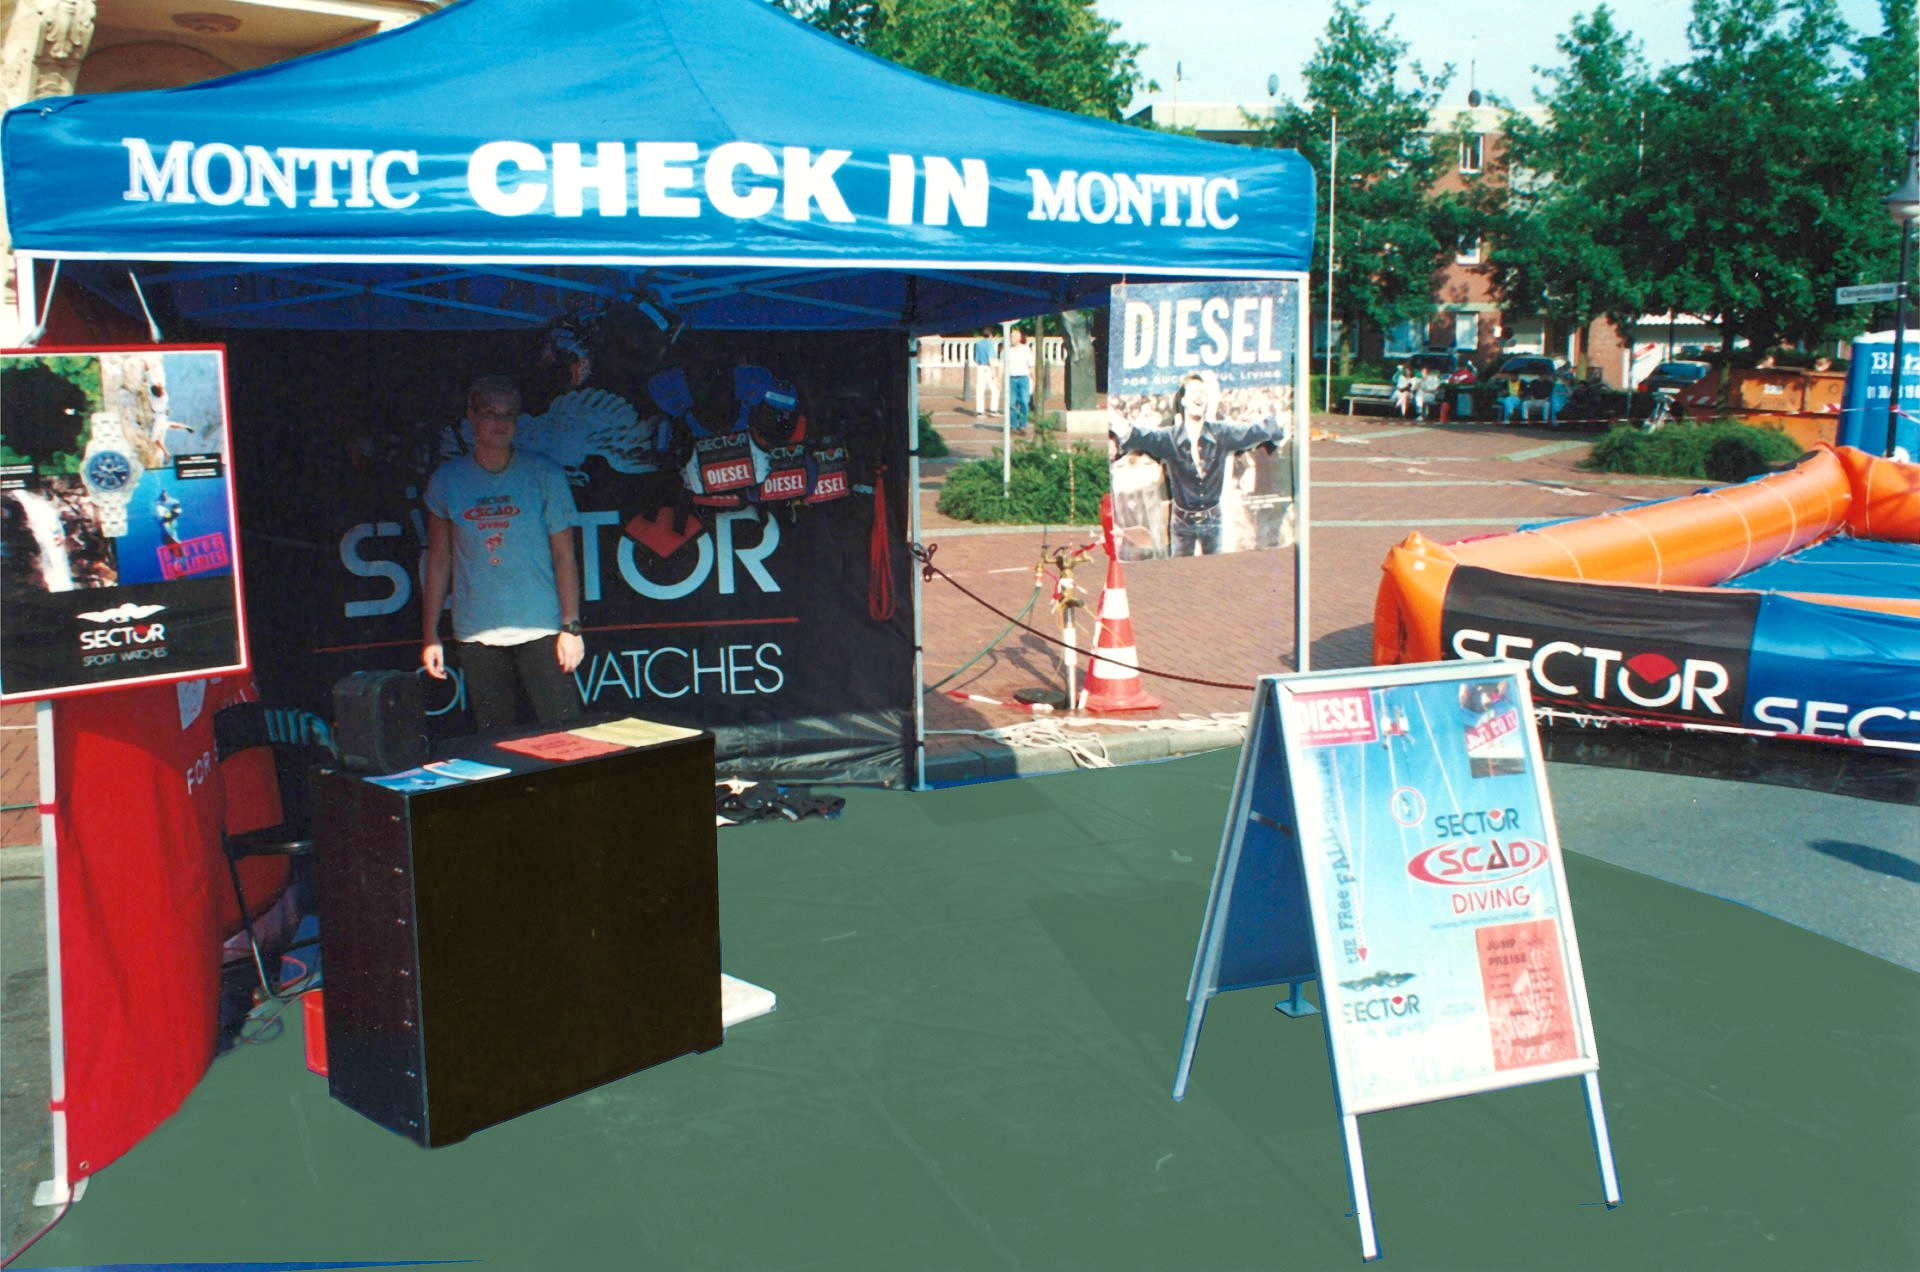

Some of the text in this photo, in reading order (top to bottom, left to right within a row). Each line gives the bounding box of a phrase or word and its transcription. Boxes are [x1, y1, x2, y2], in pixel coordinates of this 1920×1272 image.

[121, 136, 1240, 230] MONTIC CHECK IN MONTIC
[1122, 297, 1282, 370] DIESEL
[1123, 376, 1148, 387] FOR
[1240, 370, 1282, 381] LIVING
[771, 445, 805, 460] CTOR
[707, 464, 750, 485] DIESEL
[764, 475, 804, 494] DIESEL
[814, 478, 845, 496] ESEL
[340, 505, 781, 618] STOR
[80, 624, 166, 651] SECTOR
[82, 647, 167, 667] SPORT WATCHES
[1295, 697, 1371, 733] DIESEL
[1435, 808, 1520, 838] SECTOR
[1438, 839, 1530, 876] SCAD
[1452, 885, 1530, 914] DIVING
[1486, 938, 1516, 951] JUMP
[1488, 953, 1526, 966] PREISE
